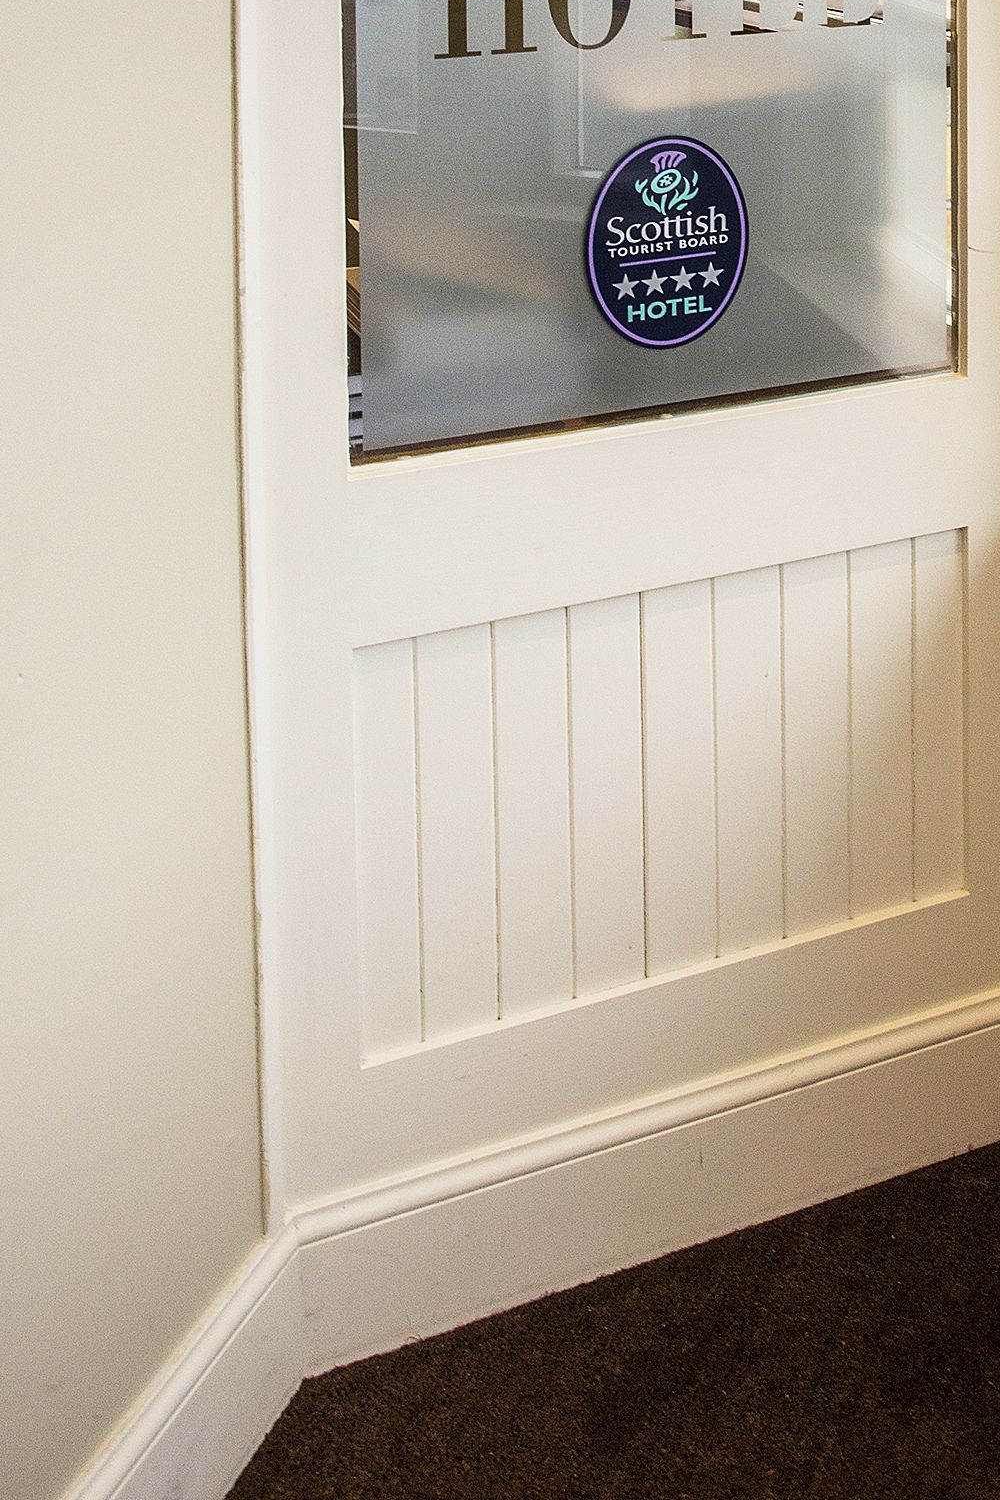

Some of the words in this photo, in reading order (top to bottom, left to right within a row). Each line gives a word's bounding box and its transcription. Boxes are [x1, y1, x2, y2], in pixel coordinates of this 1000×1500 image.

[605, 206, 728, 246] Scottish
[608, 241, 673, 258] TOURIST
[679, 234, 728, 249] BOARD
[627, 295, 712, 322] HOTEL
